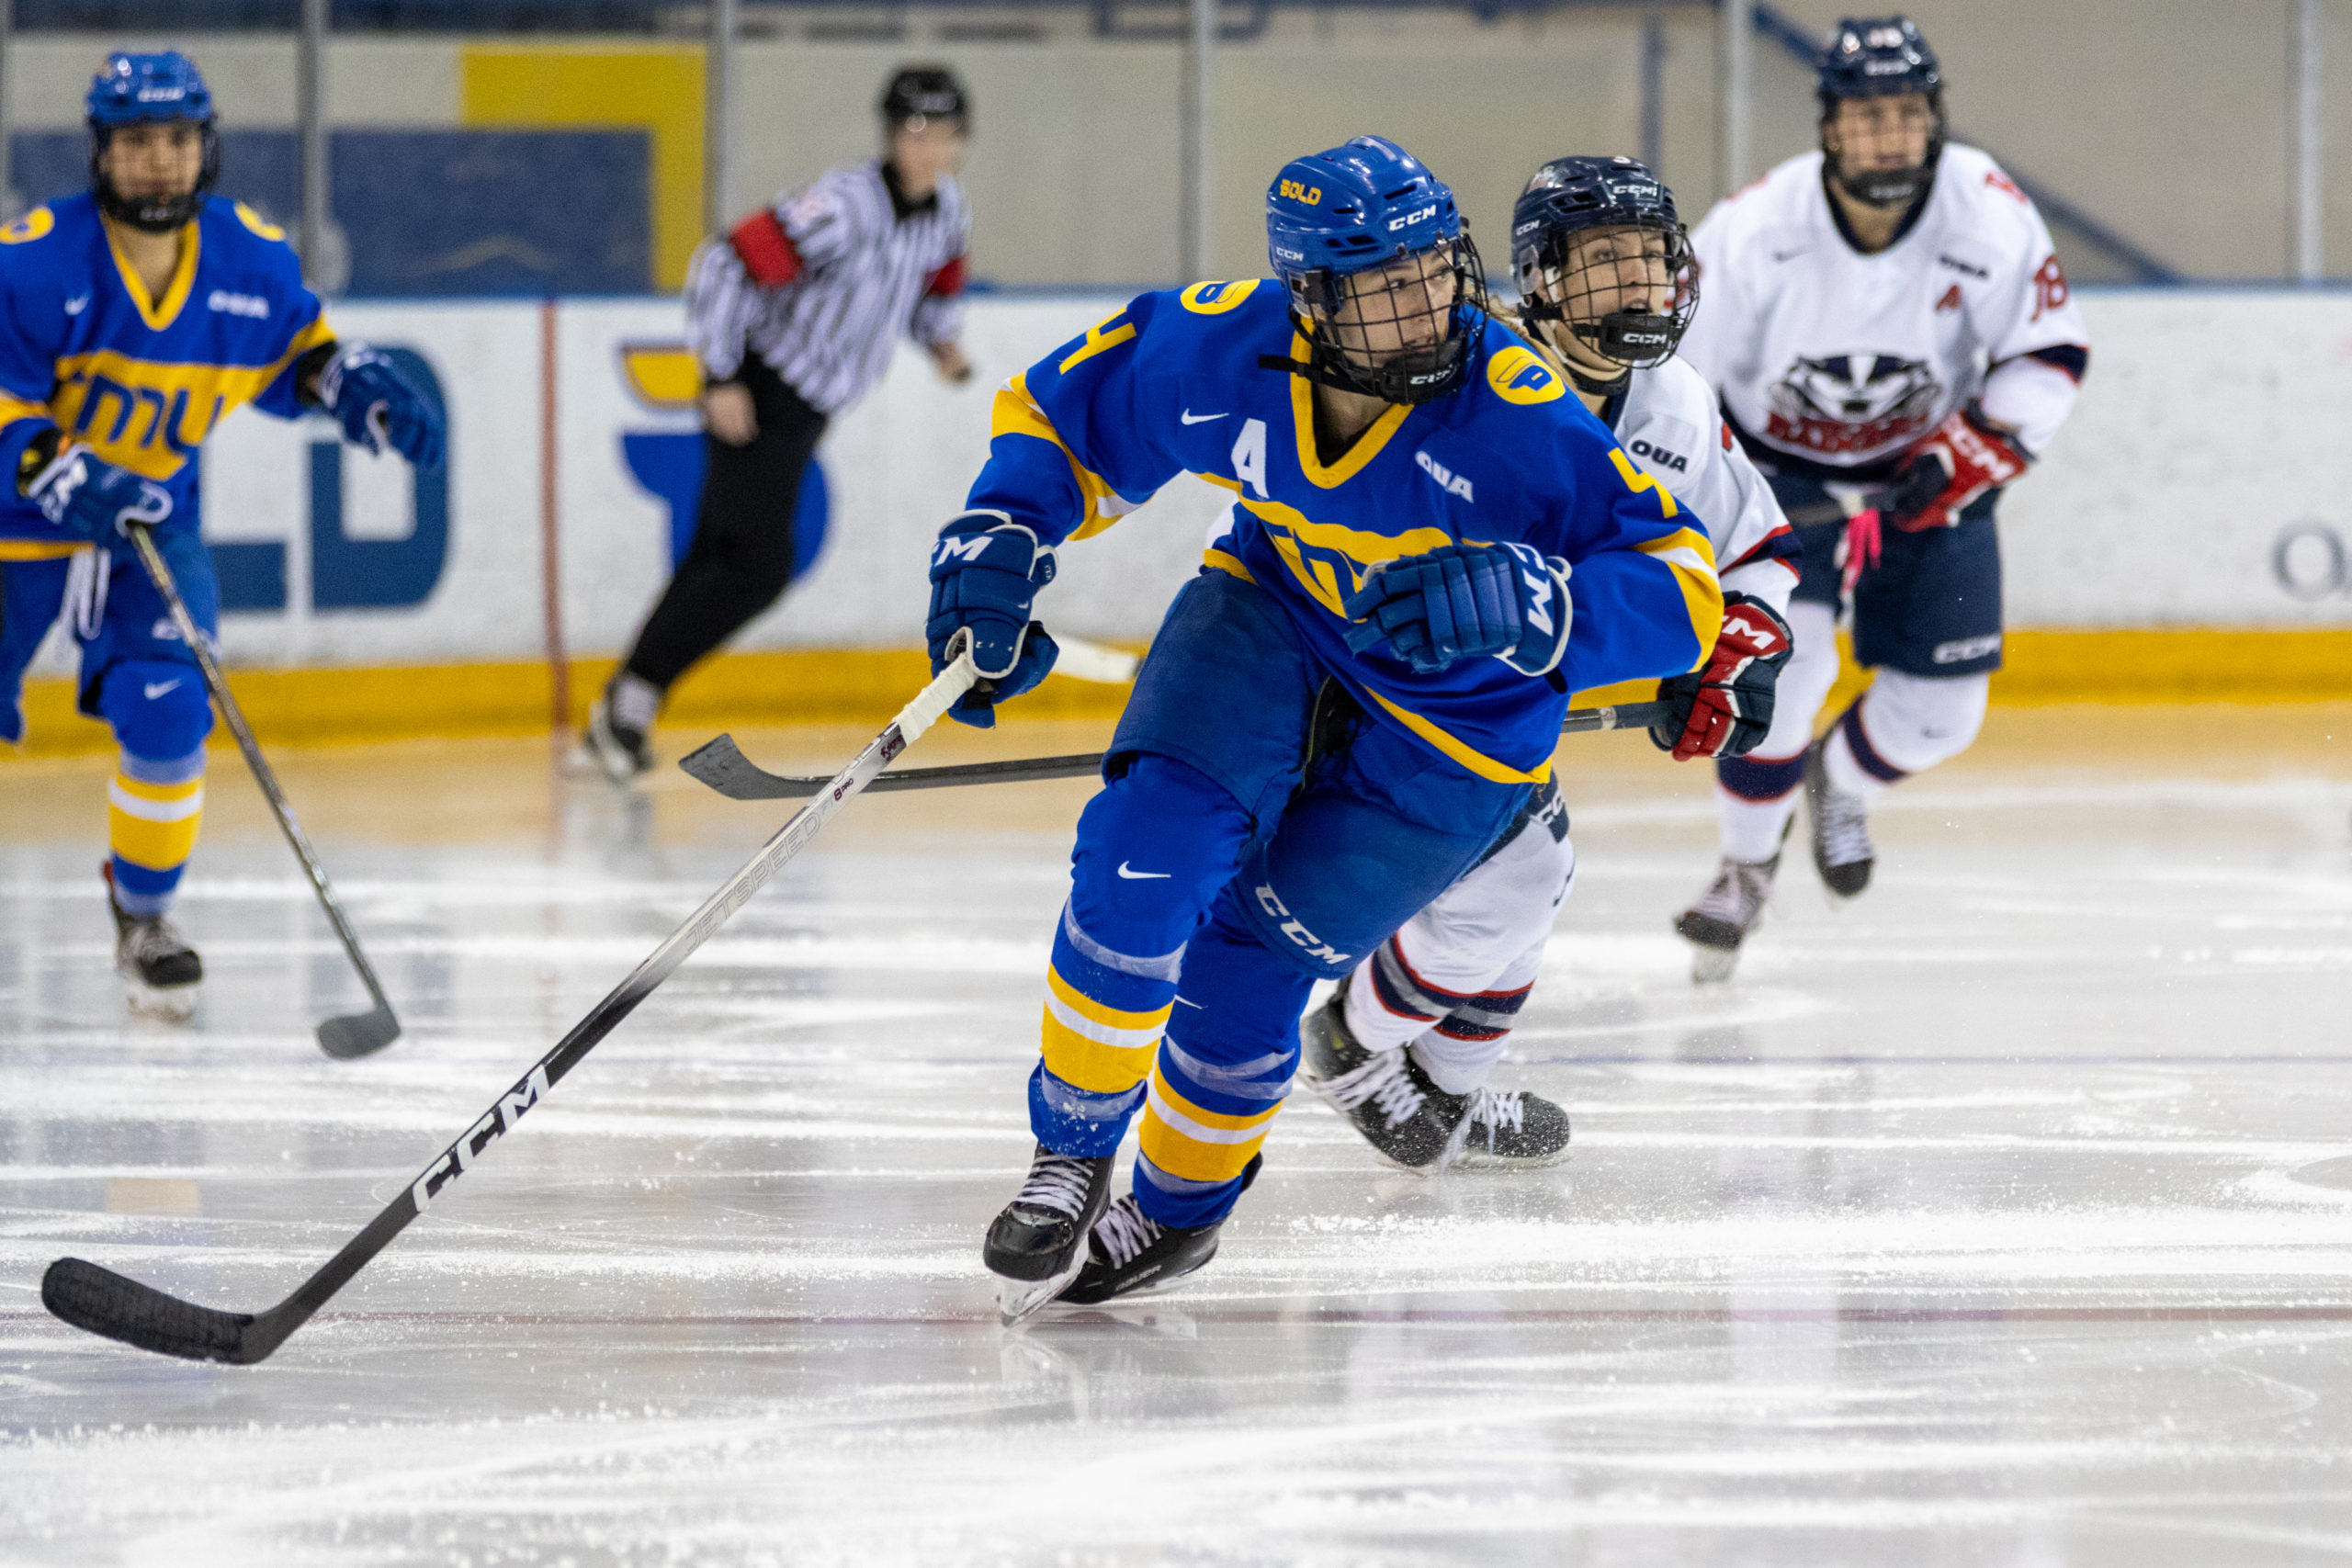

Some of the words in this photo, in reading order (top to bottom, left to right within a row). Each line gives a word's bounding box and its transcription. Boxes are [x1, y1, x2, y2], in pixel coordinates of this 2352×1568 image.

[1280, 179, 1322, 206] BOLD
[1612, 184, 1657, 197] CCM
[1388, 204, 1437, 231] CCM
[1517, 220, 1541, 236] CCM
[1276, 246, 1304, 262] CCM
[1623, 333, 1668, 345] CCM
[1231, 418, 1270, 499] A
[1631, 439, 1690, 474] OUA
[1415, 450, 1474, 503] OUA
[684, 813, 821, 953] JETSPEED
[1255, 881, 1351, 964] CCM
[413, 1064, 550, 1213] CCM
